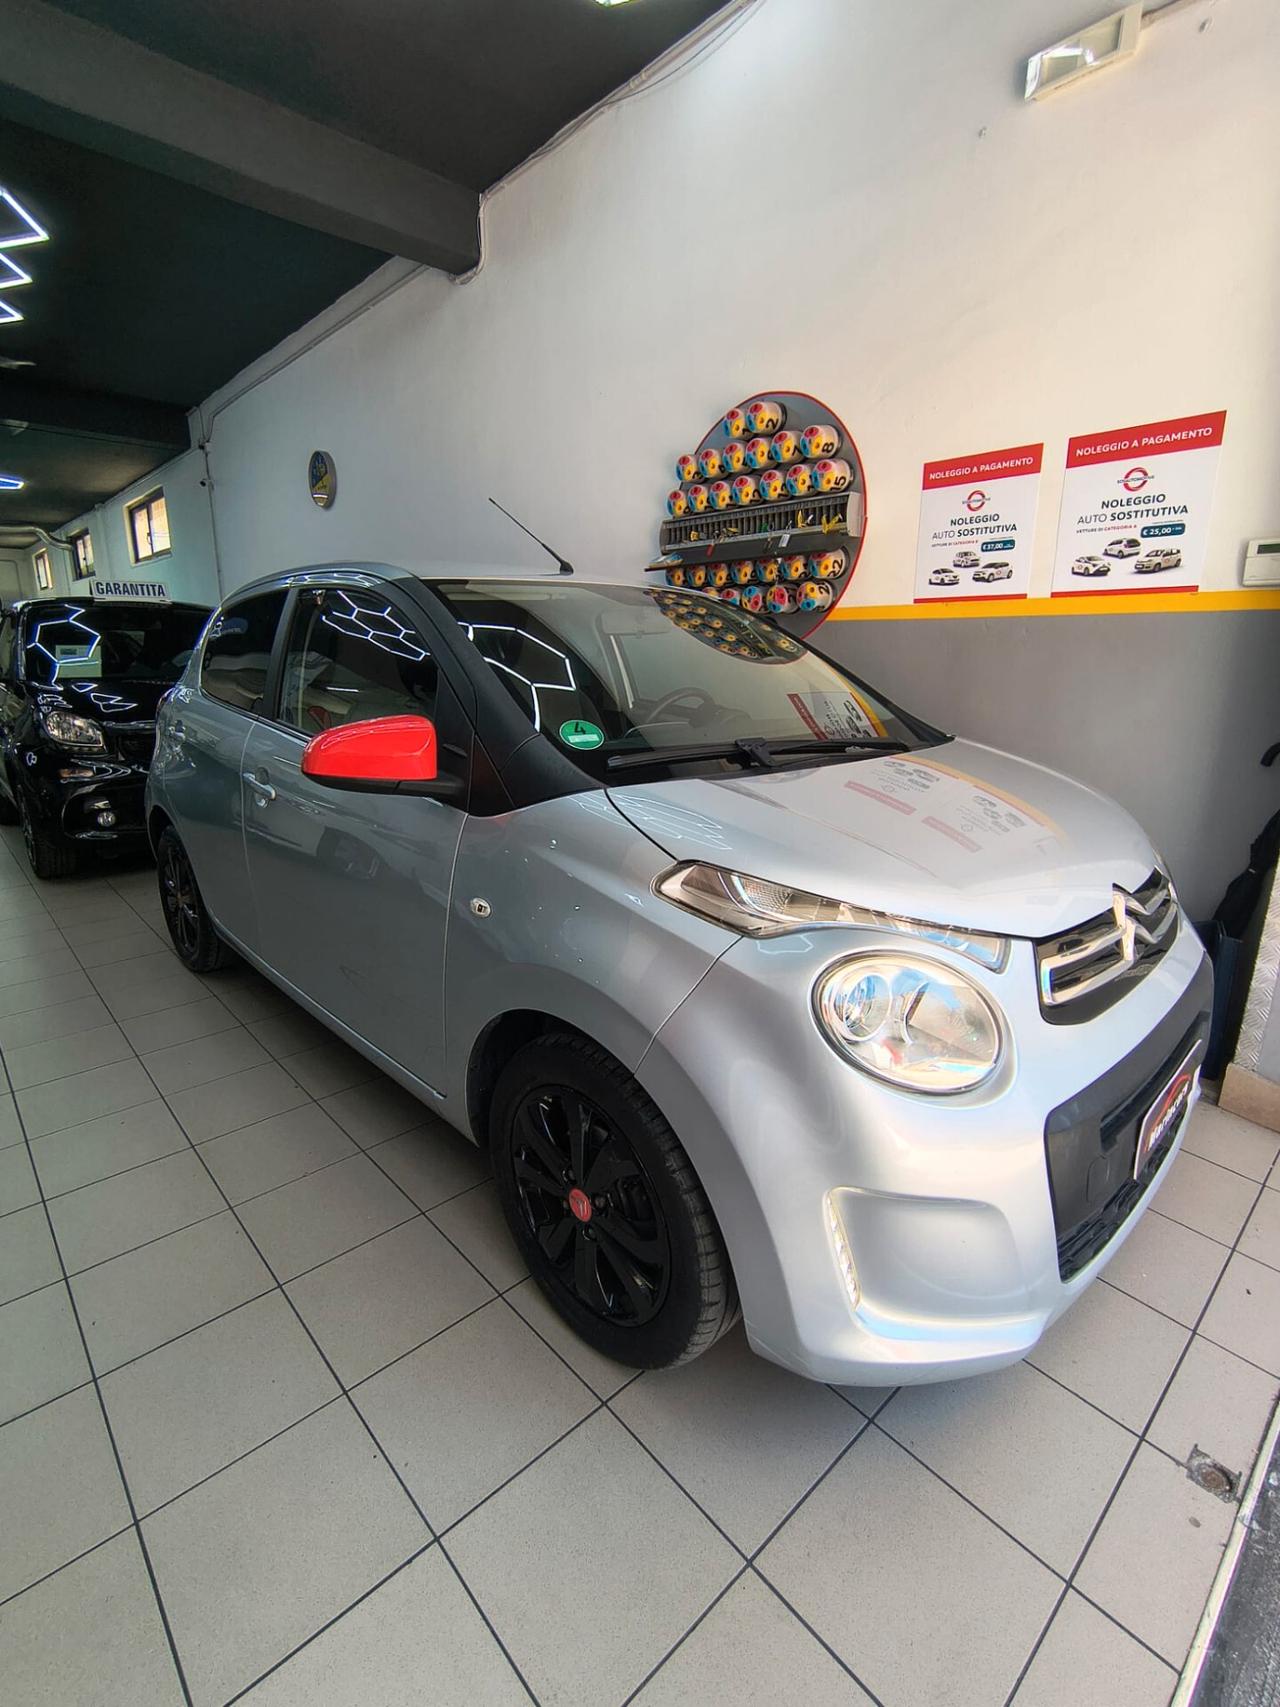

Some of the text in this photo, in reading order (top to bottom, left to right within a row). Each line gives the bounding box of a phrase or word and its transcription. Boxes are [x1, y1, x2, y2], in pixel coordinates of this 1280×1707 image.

[766, 418, 779, 429] 2
[822, 442, 834, 453] 8
[1076, 427, 1212, 457] NOLEGGIO A PAGAMENTO
[929, 468, 971, 480] NOLEGGIO
[980, 456, 1034, 472] PAGAMENTO
[830, 476, 847, 491] 15
[1101, 493, 1166, 509] NOLEGGIO
[950, 513, 1000, 526] NOLEGGIO
[1077, 505, 1189, 525] AUTO SOSTITUTIVA
[932, 523, 1017, 539] AUTO SOSTITUTIVA
[1149, 528, 1172, 536] 25,00
[95, 582, 166, 596] GARANTITA
[574, 722, 586, 734] 4
